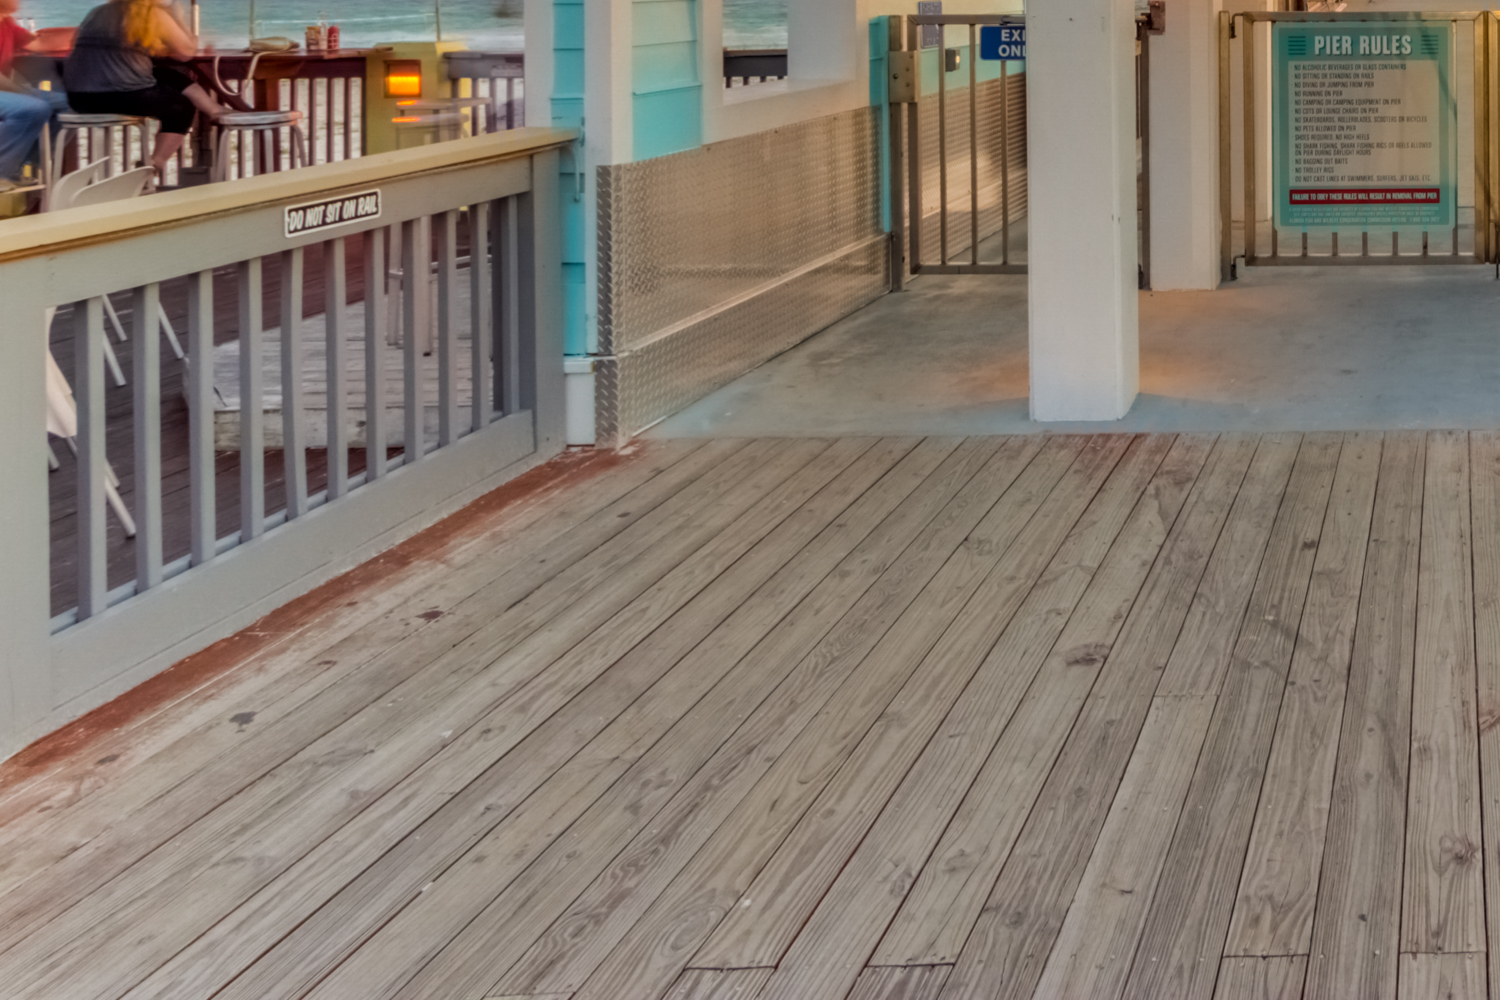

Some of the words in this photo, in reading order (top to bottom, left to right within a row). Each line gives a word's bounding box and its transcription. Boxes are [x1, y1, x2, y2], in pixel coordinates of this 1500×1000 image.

[1001, 29, 1026, 41] EXI
[998, 45, 1026, 57] ONL
[1314, 35, 1352, 55] PIER
[1359, 35, 1412, 55] RULES
[289, 210, 304, 231] DO
[305, 205, 325, 227] NOT
[325, 202, 342, 223] SIT
[342, 199, 356, 219] ON
[357, 195, 377, 216] RAIL
